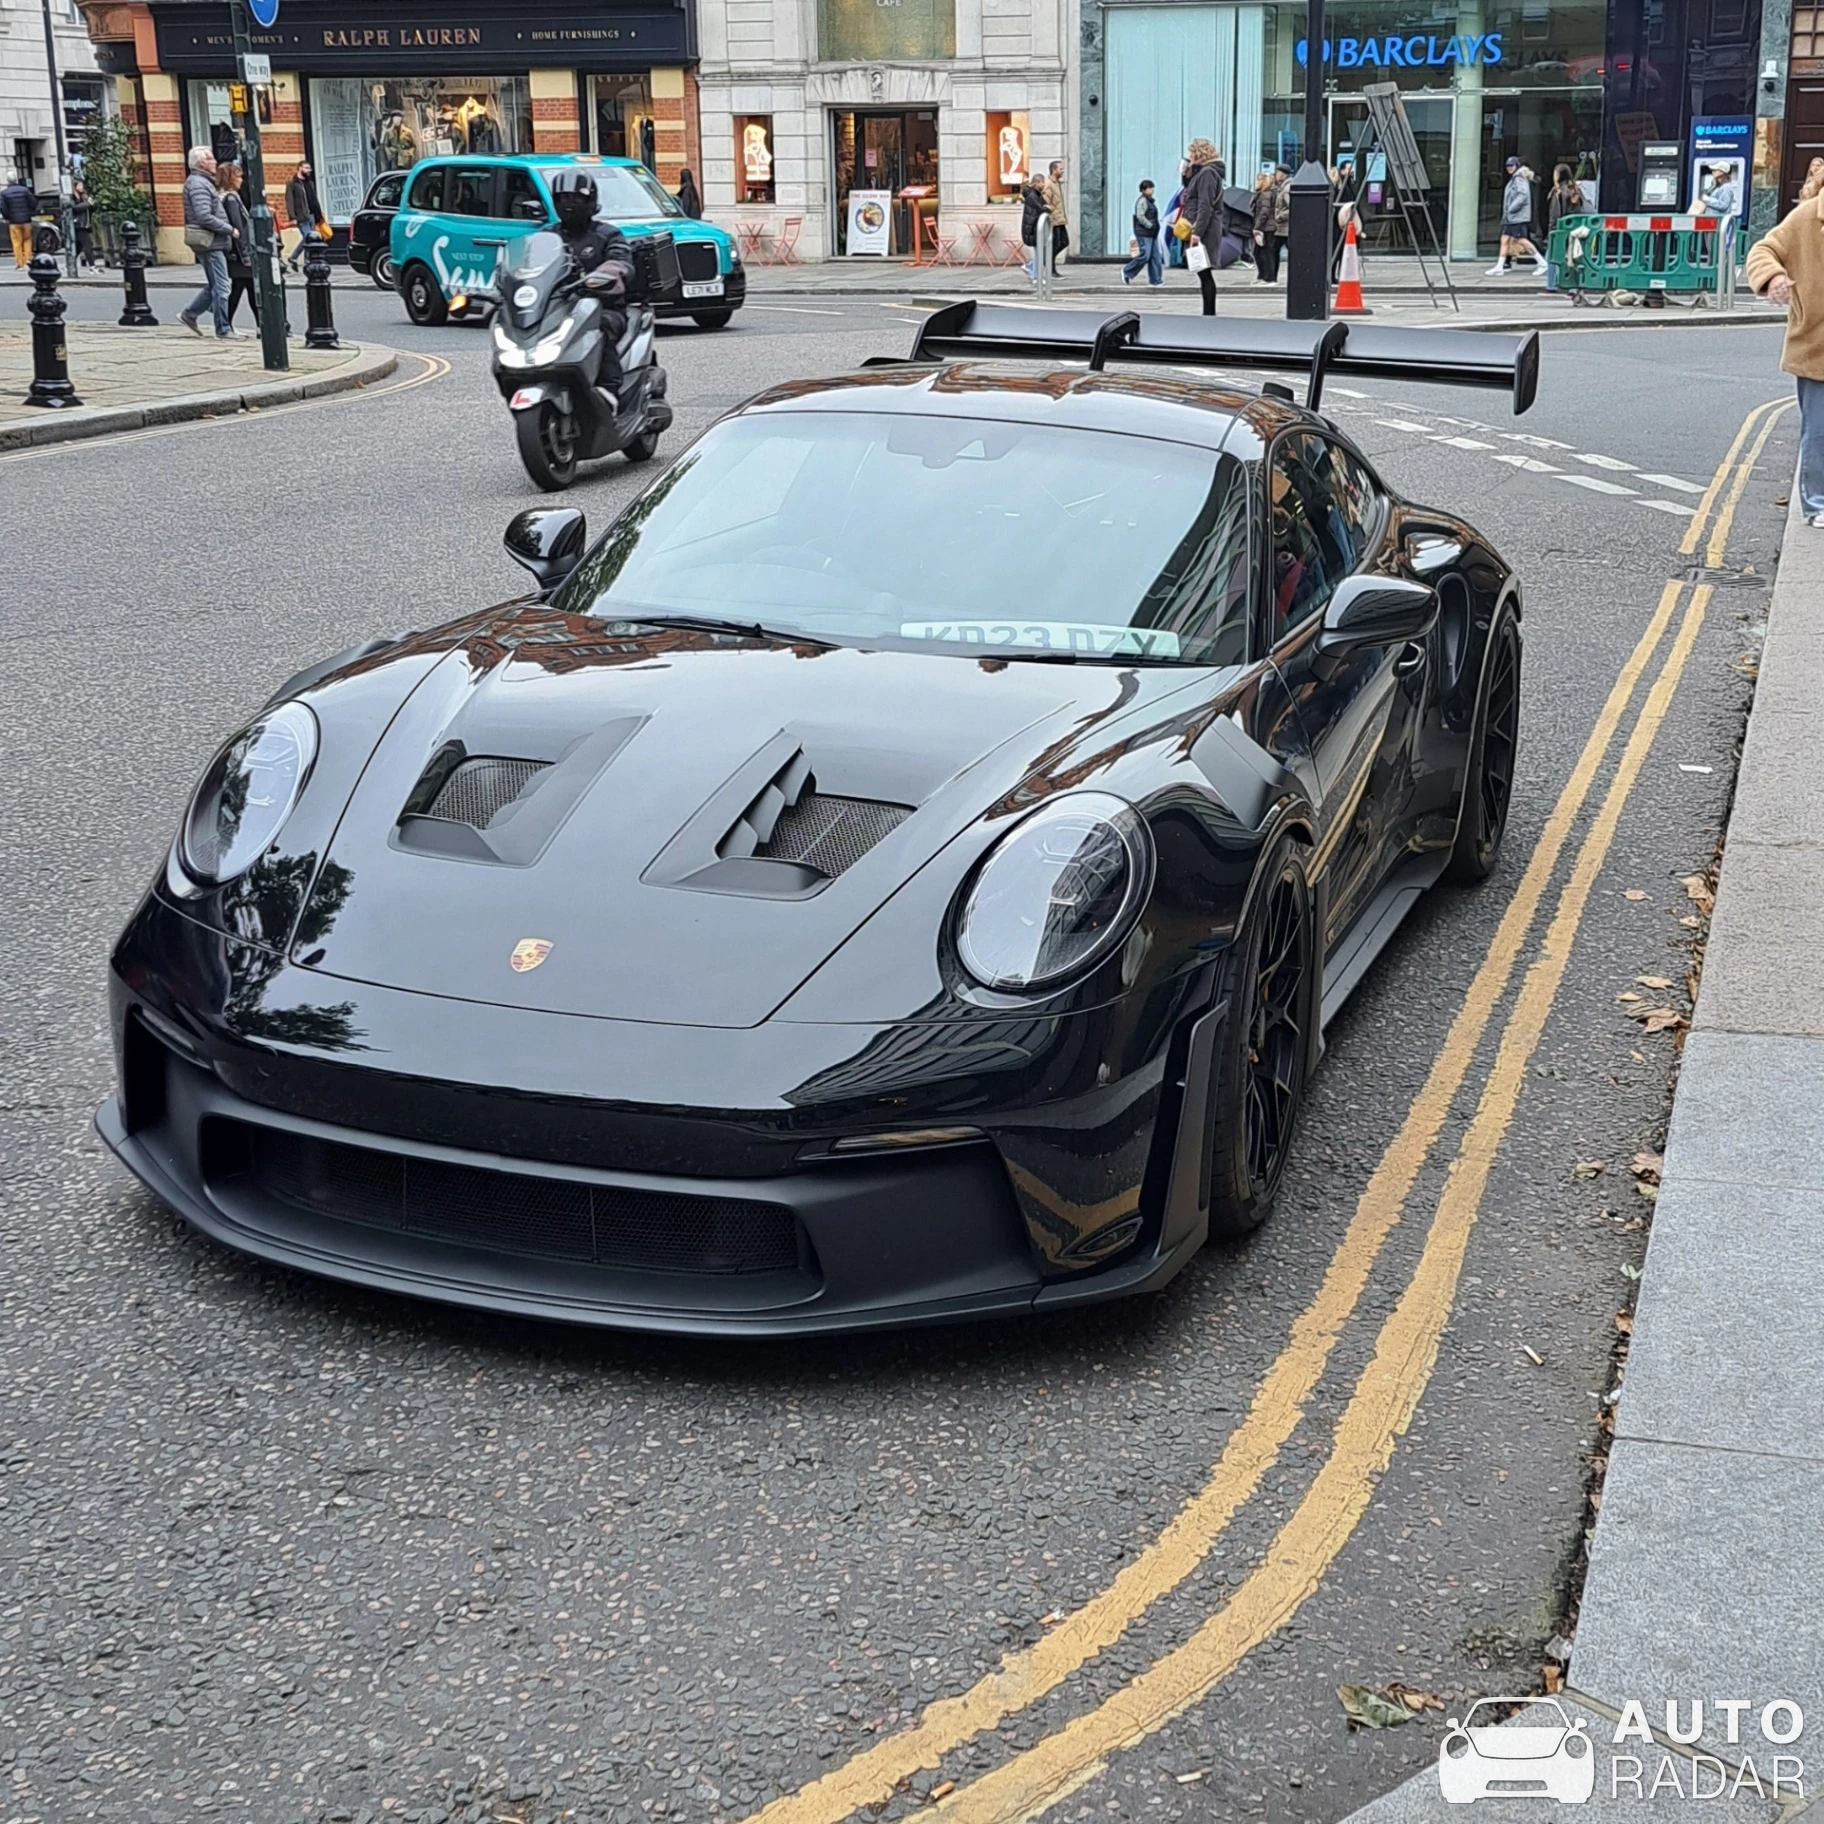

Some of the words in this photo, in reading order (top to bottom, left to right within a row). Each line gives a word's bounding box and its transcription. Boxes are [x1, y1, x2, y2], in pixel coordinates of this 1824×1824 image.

[206, 36, 233, 44] MEN'S
[251, 35, 284, 44] OMEN'S
[323, 29, 391, 46] RALPH
[400, 28, 481, 46] LAUREN
[531, 31, 557, 40] HOME
[560, 30, 620, 40] FURNISHINGS
[1337, 33, 1503, 67] BARCLAYS
[247, 62, 258, 76] One
[259, 65, 269, 78] way
[1705, 125, 1748, 134] BARCLAYS
[328, 162, 354, 175] RALPH
[330, 186, 358, 200] ICONIC
[332, 199, 357, 212] STYLE
[451, 252, 467, 261] NEXT
[468, 253, 485, 261] STOP
[514, 391, 530, 405] L
